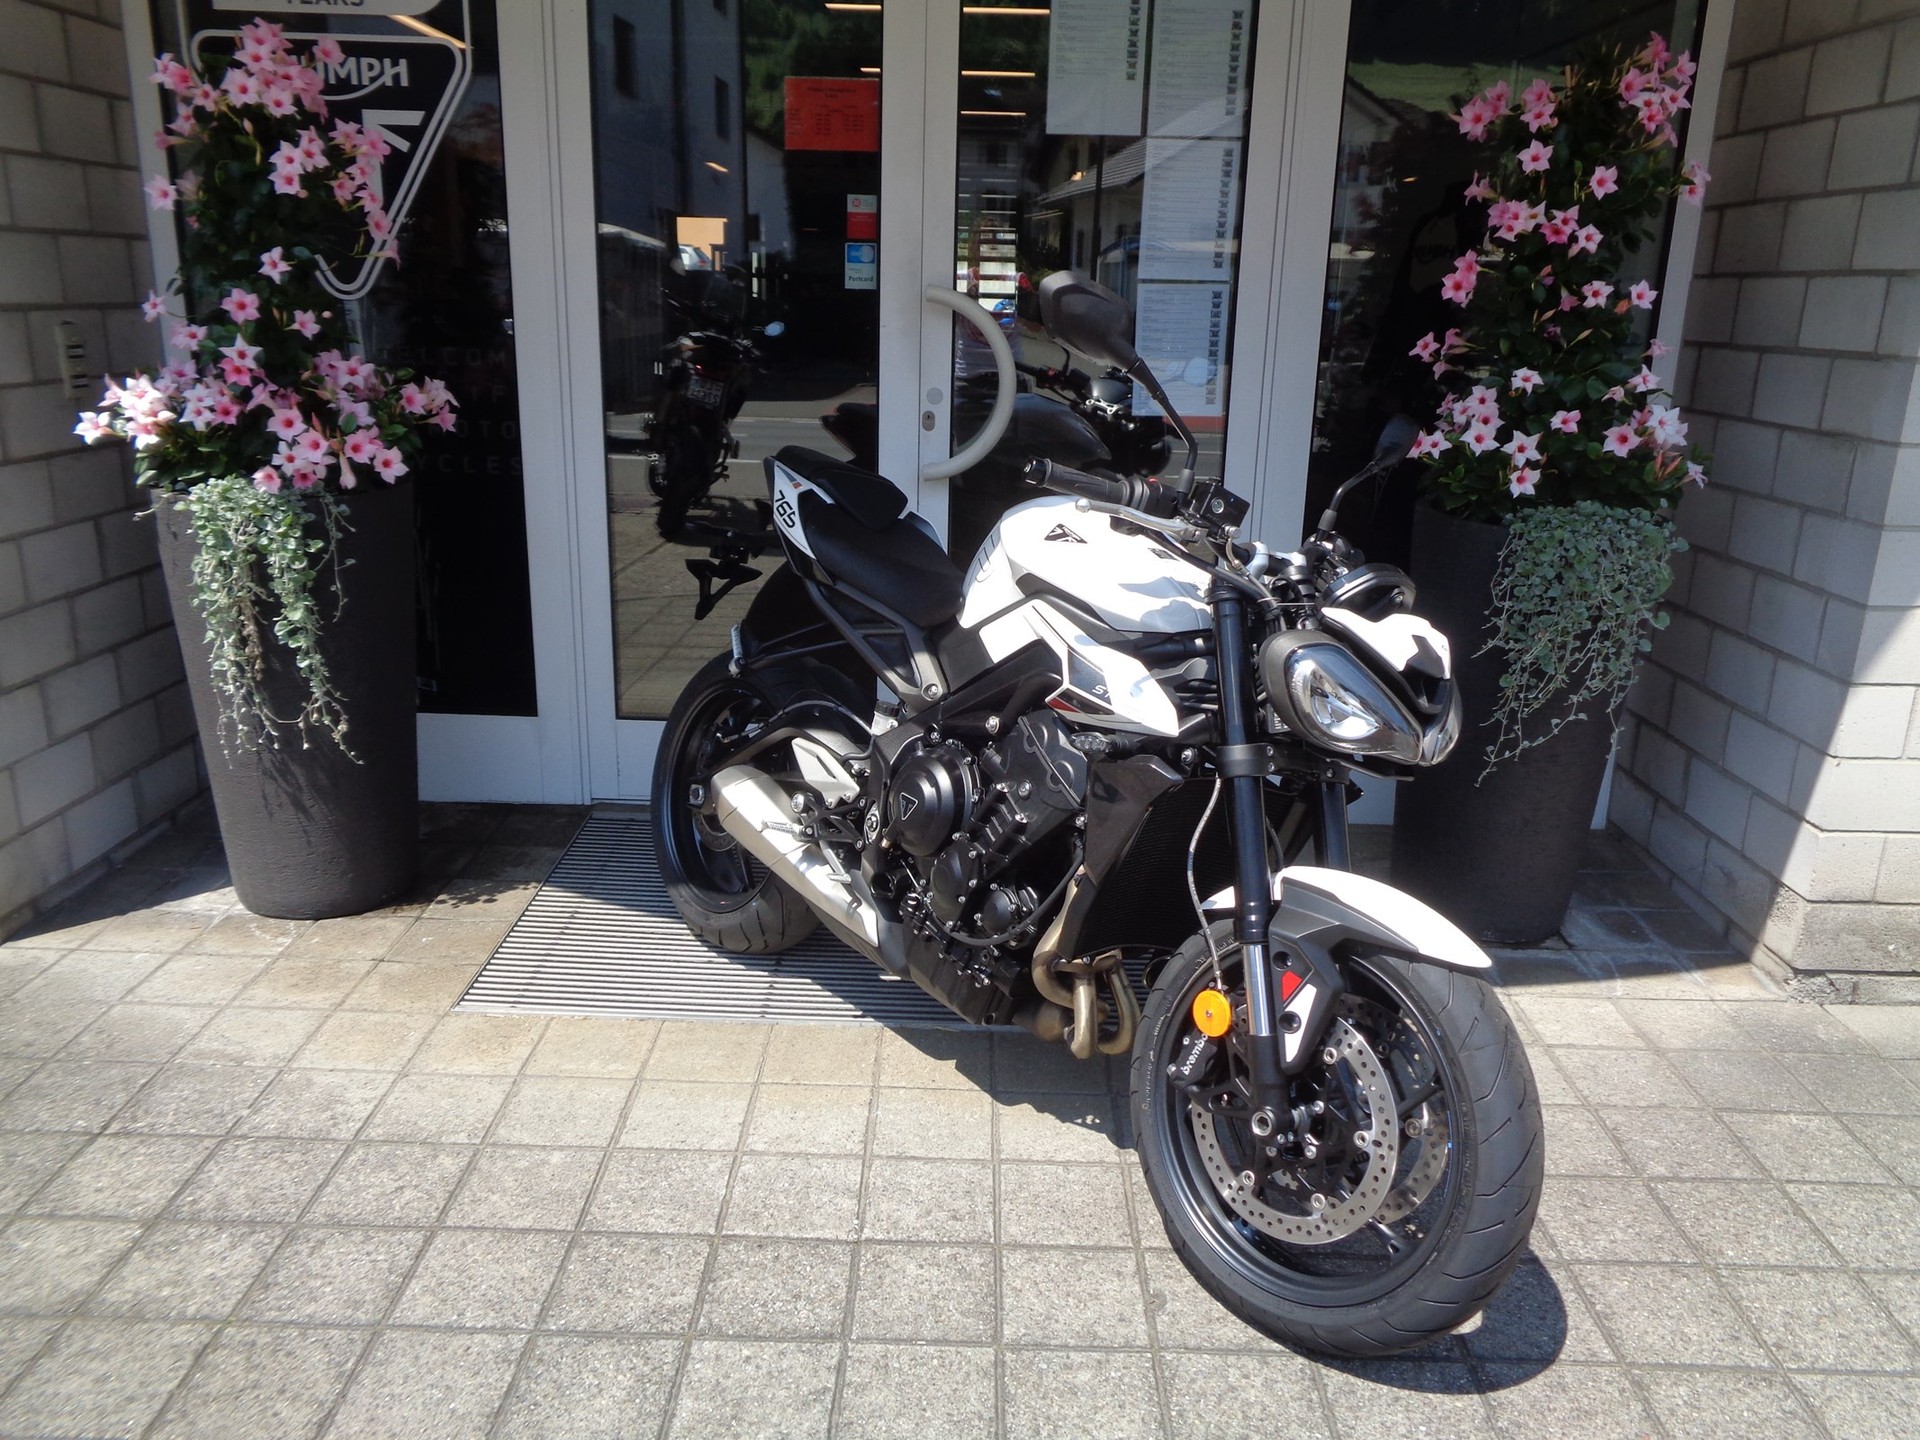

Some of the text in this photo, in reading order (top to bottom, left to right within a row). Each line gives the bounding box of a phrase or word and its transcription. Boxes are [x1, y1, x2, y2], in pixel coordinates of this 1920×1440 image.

[414, 453, 522, 476] YCLES
[774, 489, 796, 528] 765
[1180, 1033, 1208, 1076] brembo
